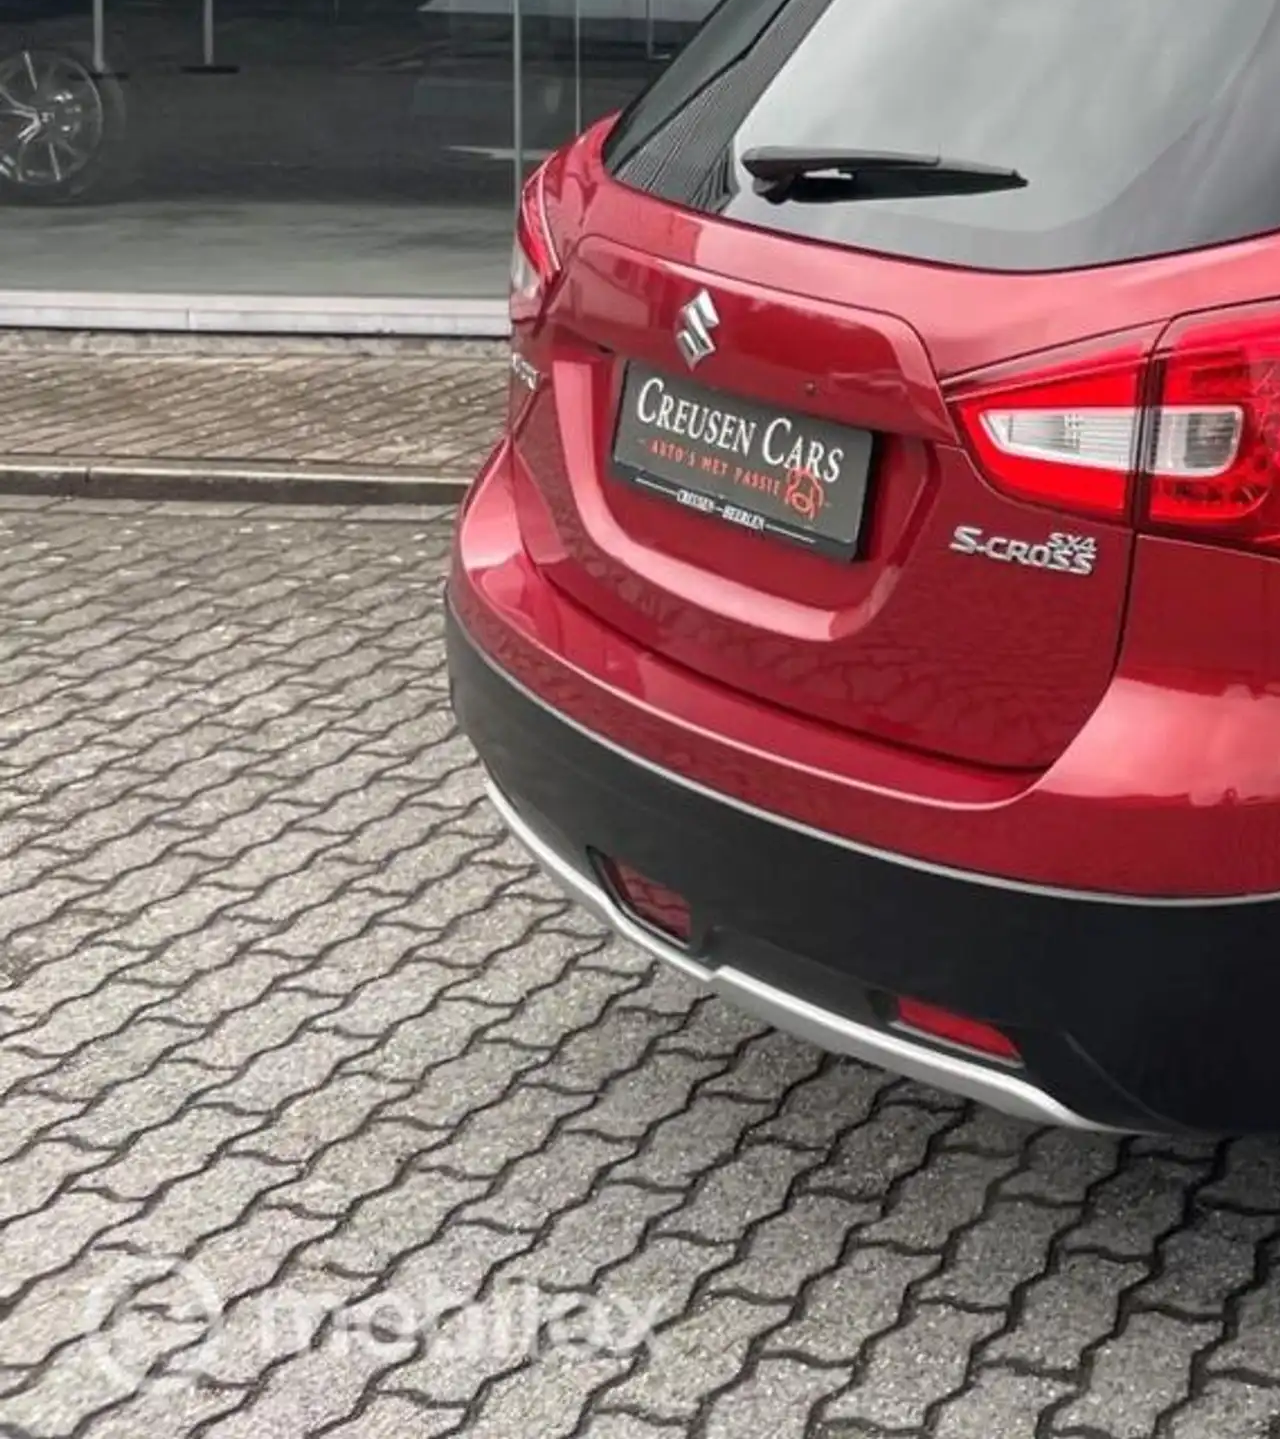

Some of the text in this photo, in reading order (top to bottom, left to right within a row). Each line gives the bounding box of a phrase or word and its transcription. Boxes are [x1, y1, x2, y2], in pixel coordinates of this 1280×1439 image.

[637, 377, 844, 483] CREUSEN CARS
[702, 453, 728, 477] MET
[1048, 532, 1097, 552] SX4
